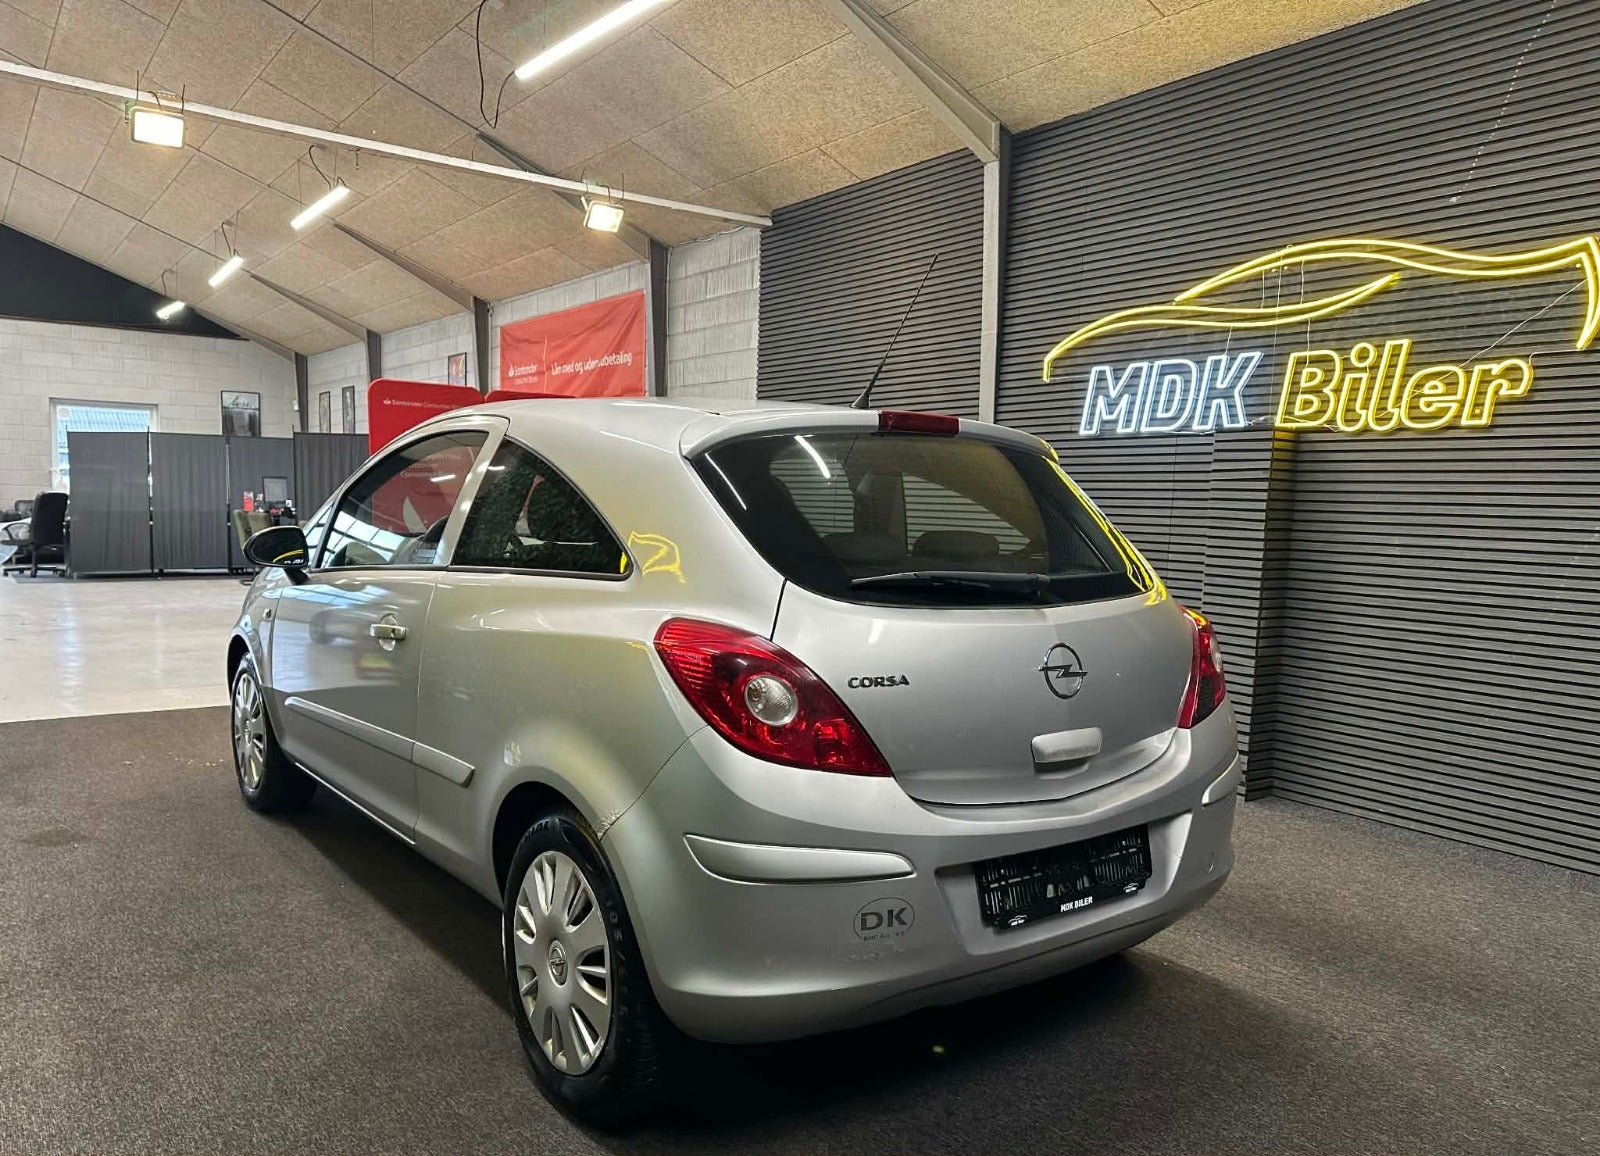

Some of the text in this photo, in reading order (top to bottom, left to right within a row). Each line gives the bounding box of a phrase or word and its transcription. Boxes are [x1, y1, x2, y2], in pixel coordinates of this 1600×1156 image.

[574, 361, 583, 374] og
[1079, 338, 1534, 436] MDK Biler
[848, 675, 910, 688] CORSA
[1074, 896, 1093, 909] BILER
[860, 907, 908, 931] DK
